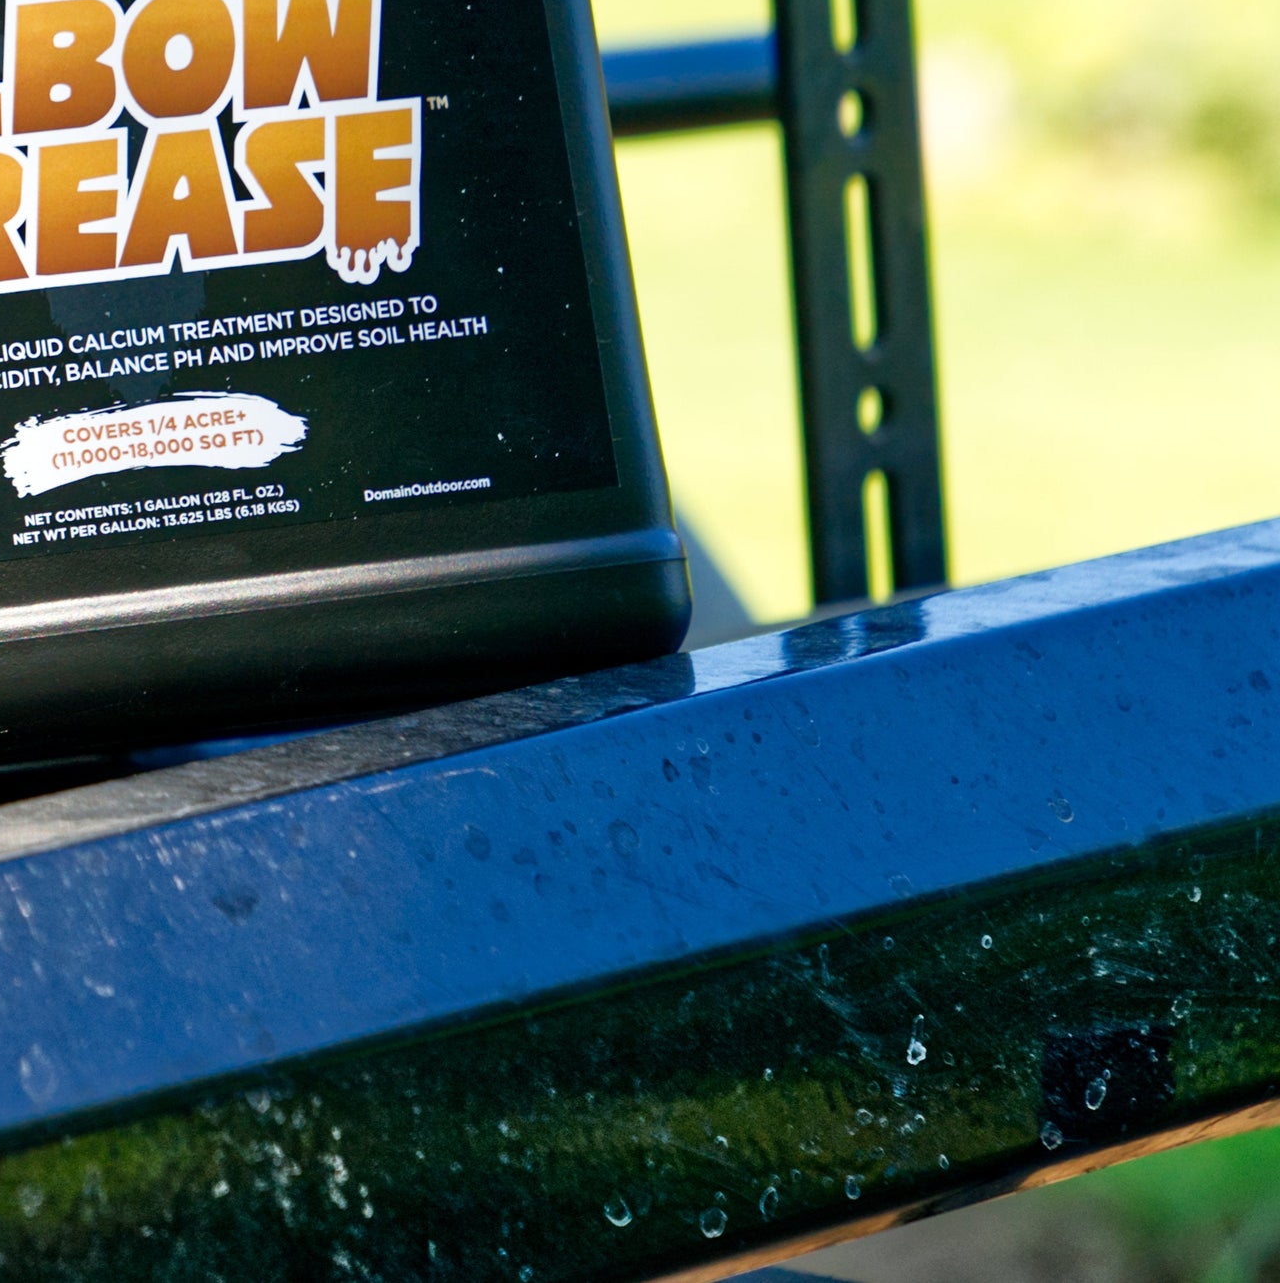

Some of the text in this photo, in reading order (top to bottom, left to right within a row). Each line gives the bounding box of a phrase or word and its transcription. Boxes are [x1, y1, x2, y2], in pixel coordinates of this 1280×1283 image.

[68, 326, 166, 355] CALCIUM
[169, 311, 295, 342] TREATMENT
[300, 298, 405, 327] DESIGNED
[407, 295, 438, 315] TO
[65, 349, 170, 382] BALANCE
[173, 346, 203, 368] PH
[208, 340, 255, 365] AND
[259, 328, 354, 359] IMPROVE
[357, 325, 406, 348] SOIL
[408, 316, 488, 343] HEALTH
[62, 409, 247, 445] COVERS 1/4 ACRE+
[51, 429, 265, 470] (11,000-18,000 SQ FT)
[24, 484, 284, 527] NET CONTENTS: 1 GALLON (128 FL. OZ.)
[364, 477, 491, 502] DomainOutdoor.com
[12, 498, 300, 546] NET WT PER GALLON: 13.625 LBS (6.18 KGS)
